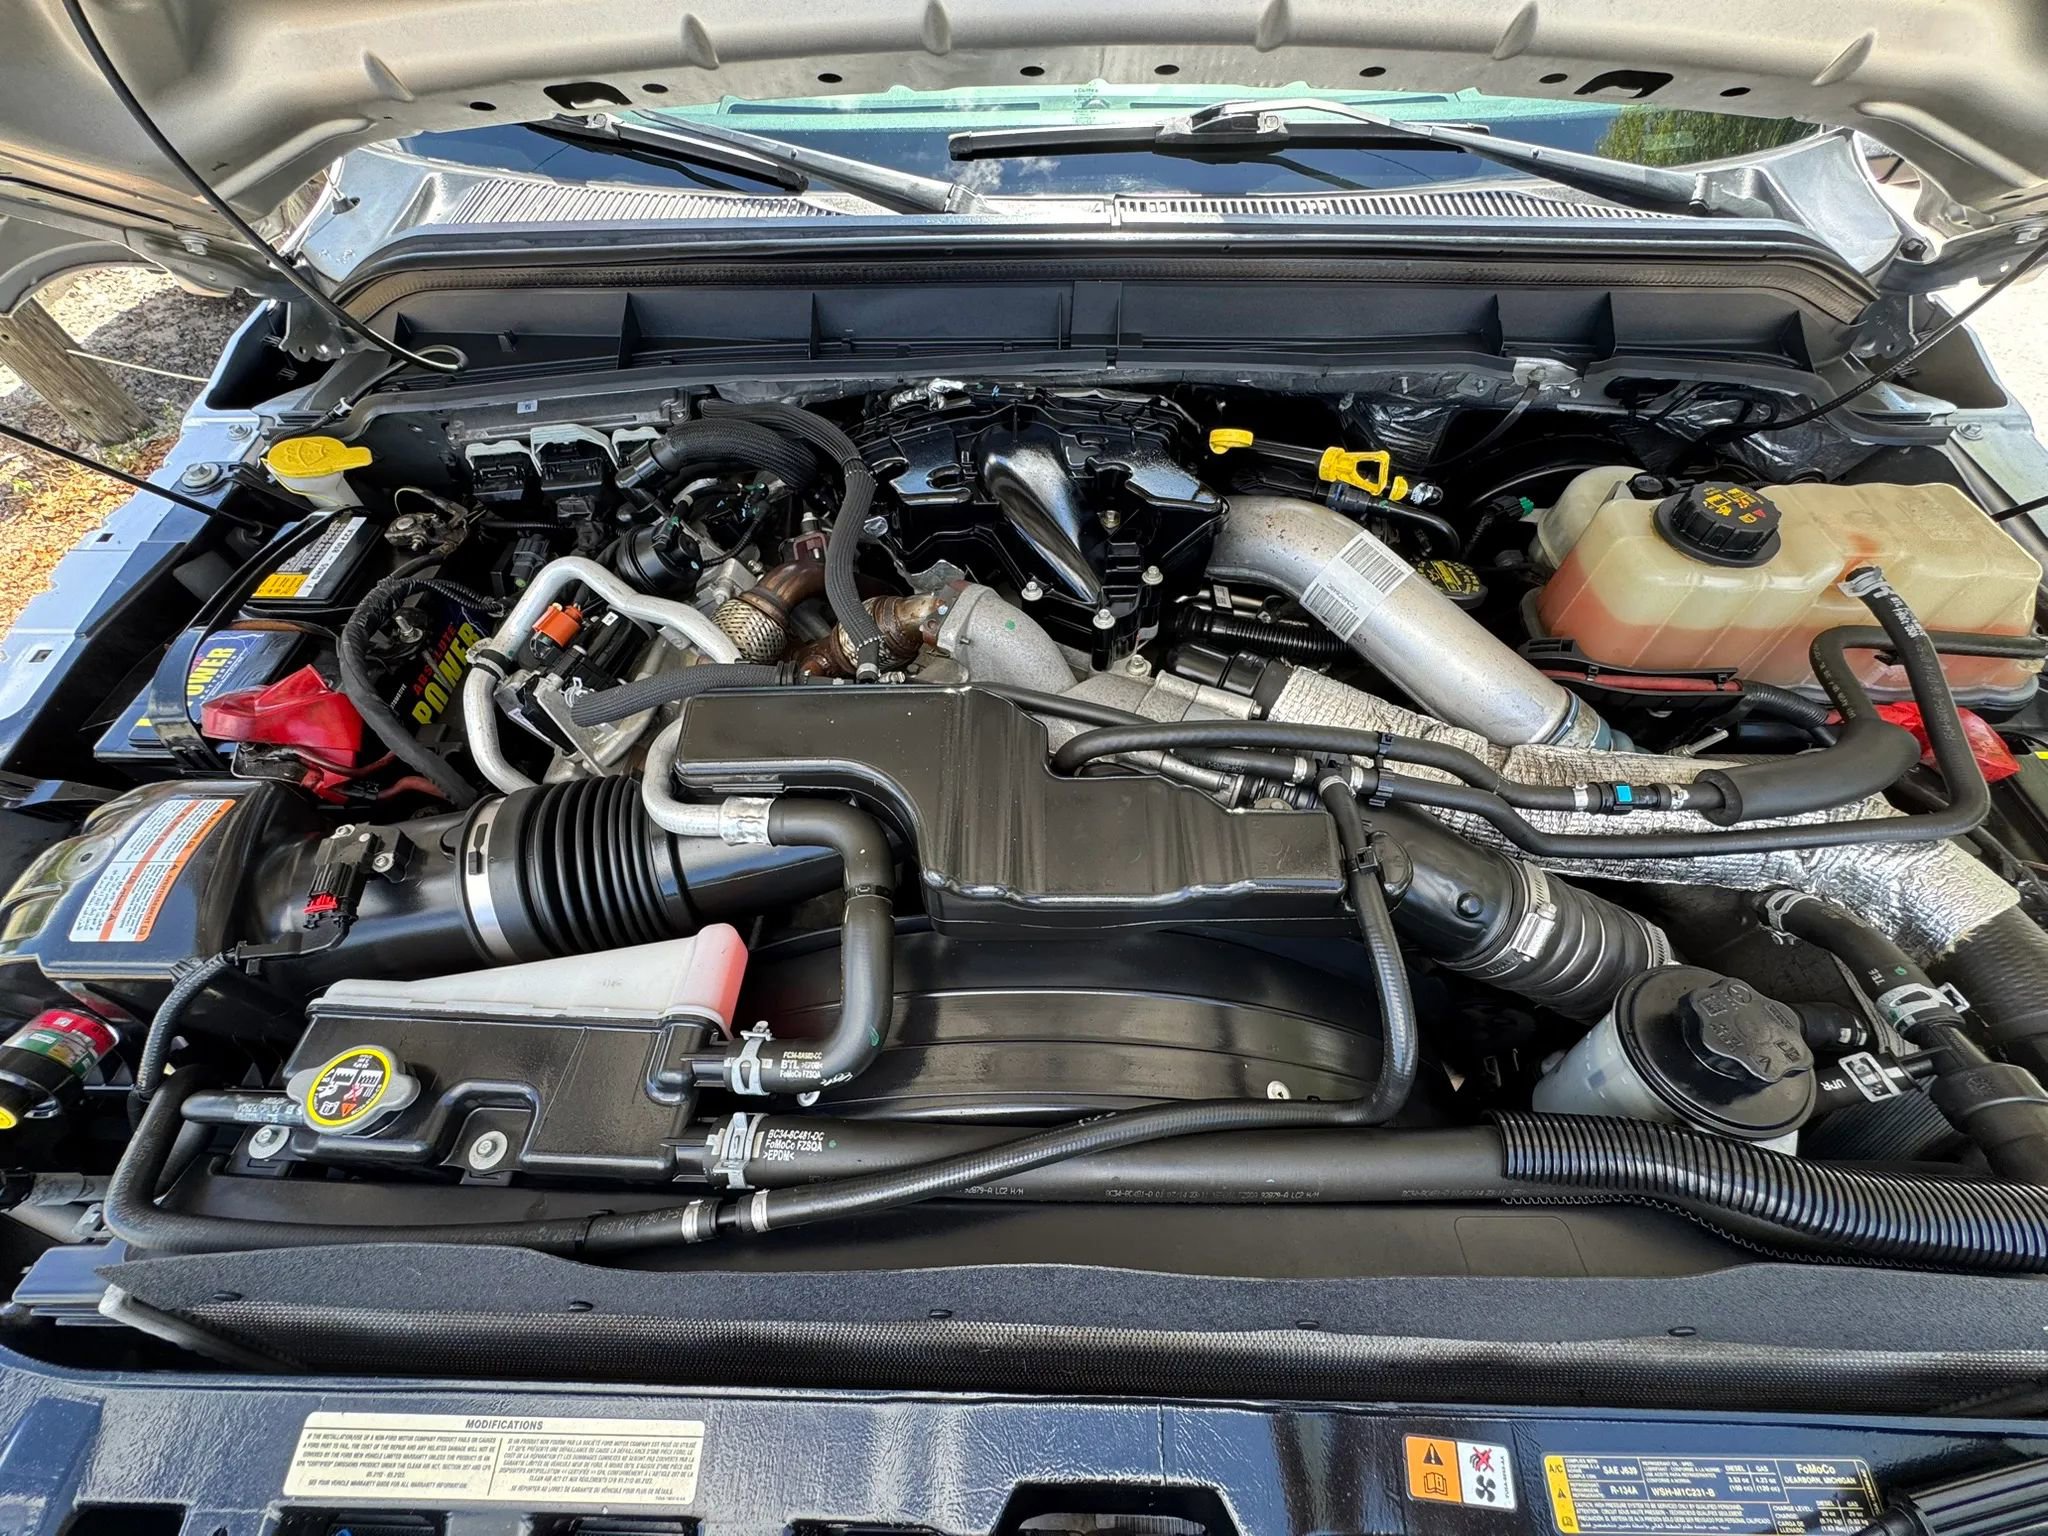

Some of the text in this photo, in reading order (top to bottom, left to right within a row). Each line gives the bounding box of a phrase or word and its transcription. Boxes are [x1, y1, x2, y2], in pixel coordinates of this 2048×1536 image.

[413, 623, 457, 696] ABSLUTE
[187, 647, 237, 706] OWER
[1867, 966, 1886, 987] TEE
[781, 1060, 799, 1069] BTL
[780, 1069, 801, 1078] FoMoCo
[1820, 1078, 1847, 1091] UPR
[765, 1139, 823, 1152] FoMoCo FZSQA
[763, 1149, 795, 1161] >EPDM<
[465, 1419, 543, 1430] MODIFICATIONS
[1549, 1463, 1563, 1473] A/C
[1602, 1465, 1619, 1475] SAE
[1724, 1464, 1746, 1472] DIESEL
[1795, 1463, 1836, 1474] FoMoCo
[1823, 1476, 1857, 1485] MICHIGAN
[1609, 1485, 1638, 1495] R-134A
[1650, 1487, 1716, 1497] WSH-M1C231-B
